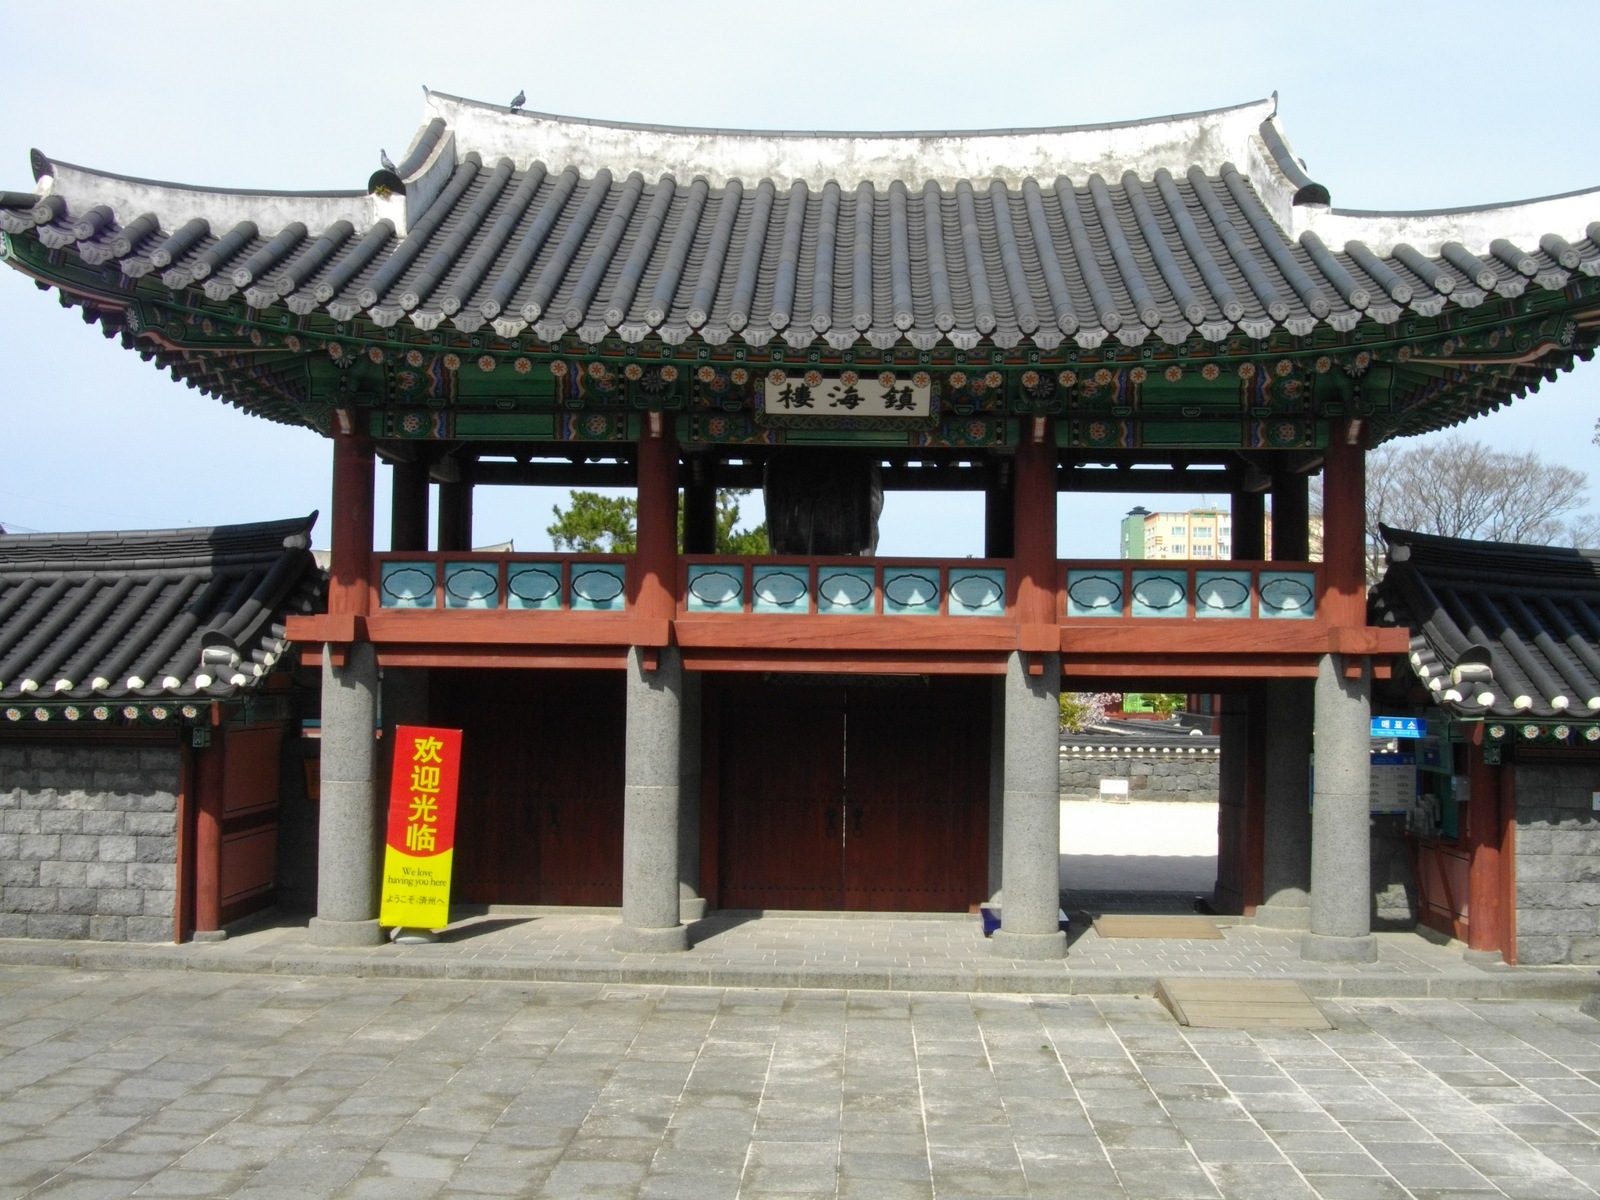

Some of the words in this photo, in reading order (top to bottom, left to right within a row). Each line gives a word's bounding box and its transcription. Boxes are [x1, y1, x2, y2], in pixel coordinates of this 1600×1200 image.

[1381, 720, 1416, 730] 매표소
[406, 736, 444, 852] 欢迎光临
[402, 867, 416, 876] We
[417, 868, 433, 877] love
[388, 875, 413, 888] having
[415, 878, 429, 888] you
[430, 878, 447, 887] here
